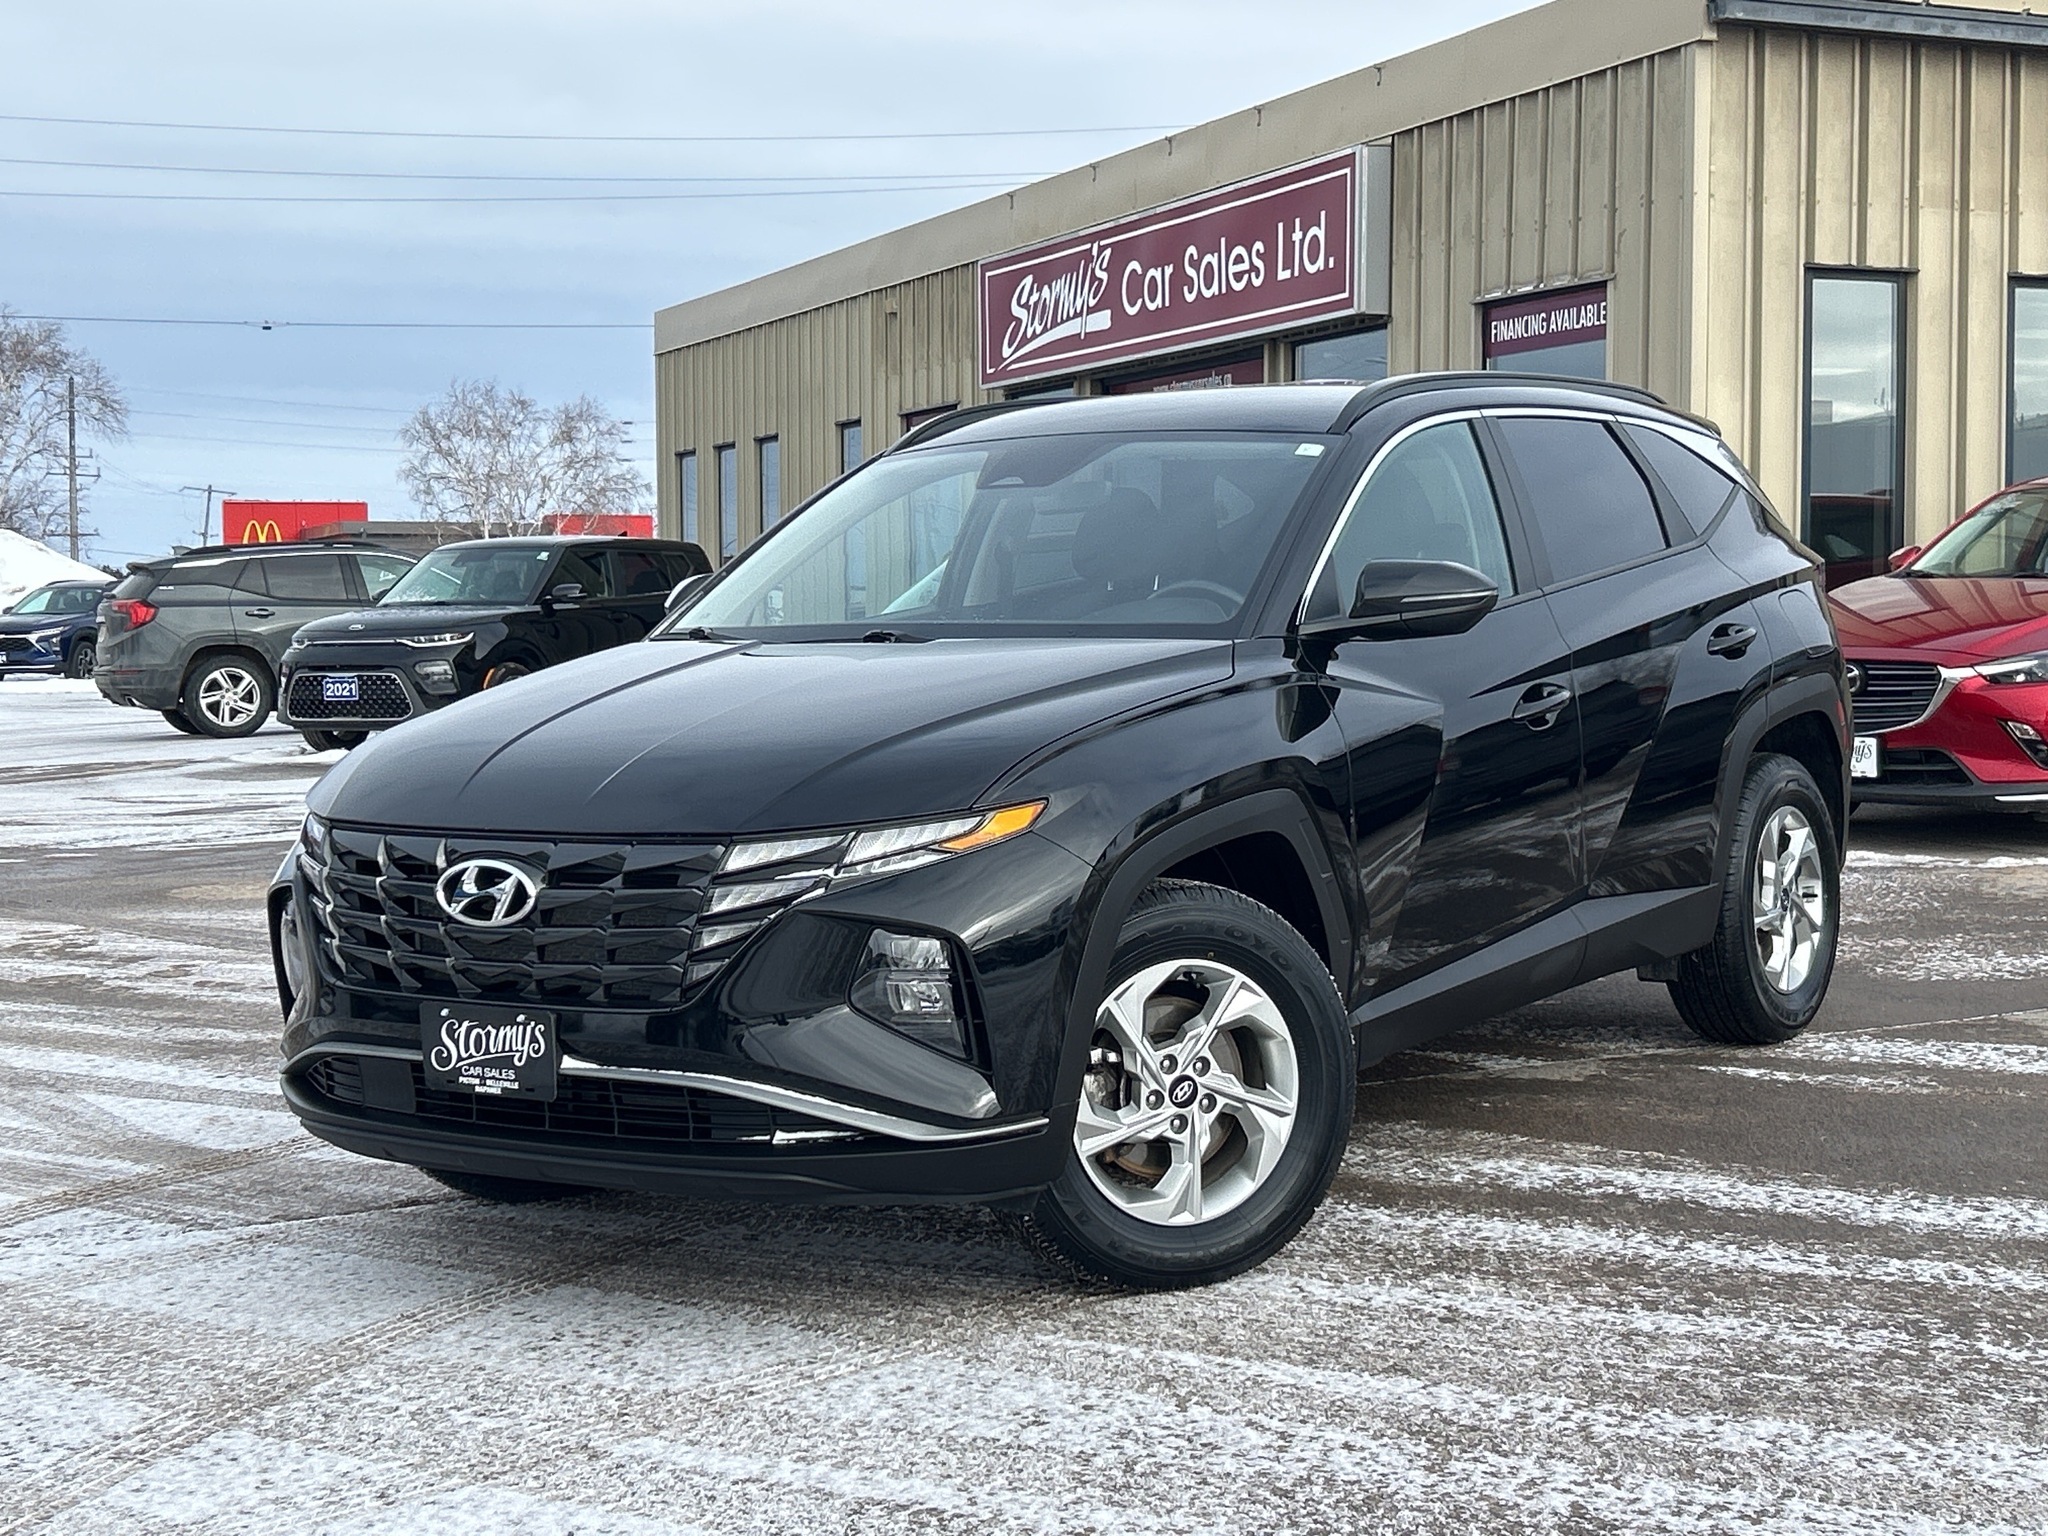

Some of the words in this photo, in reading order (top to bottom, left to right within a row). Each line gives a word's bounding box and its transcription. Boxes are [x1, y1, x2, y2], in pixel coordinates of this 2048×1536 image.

[1002, 241, 1111, 359] Stormy's
[1121, 260, 1174, 316] Car
[1183, 236, 1265, 303] Sales
[1276, 209, 1335, 281] Ltd.
[1490, 312, 1547, 343] FINANCING
[1548, 301, 1607, 334] AVAILABLE
[326, 682, 356, 696] 2021
[430, 1018, 546, 1072] Stormy's
[461, 1065, 483, 1077] CAR
[483, 1067, 516, 1080] SALES
